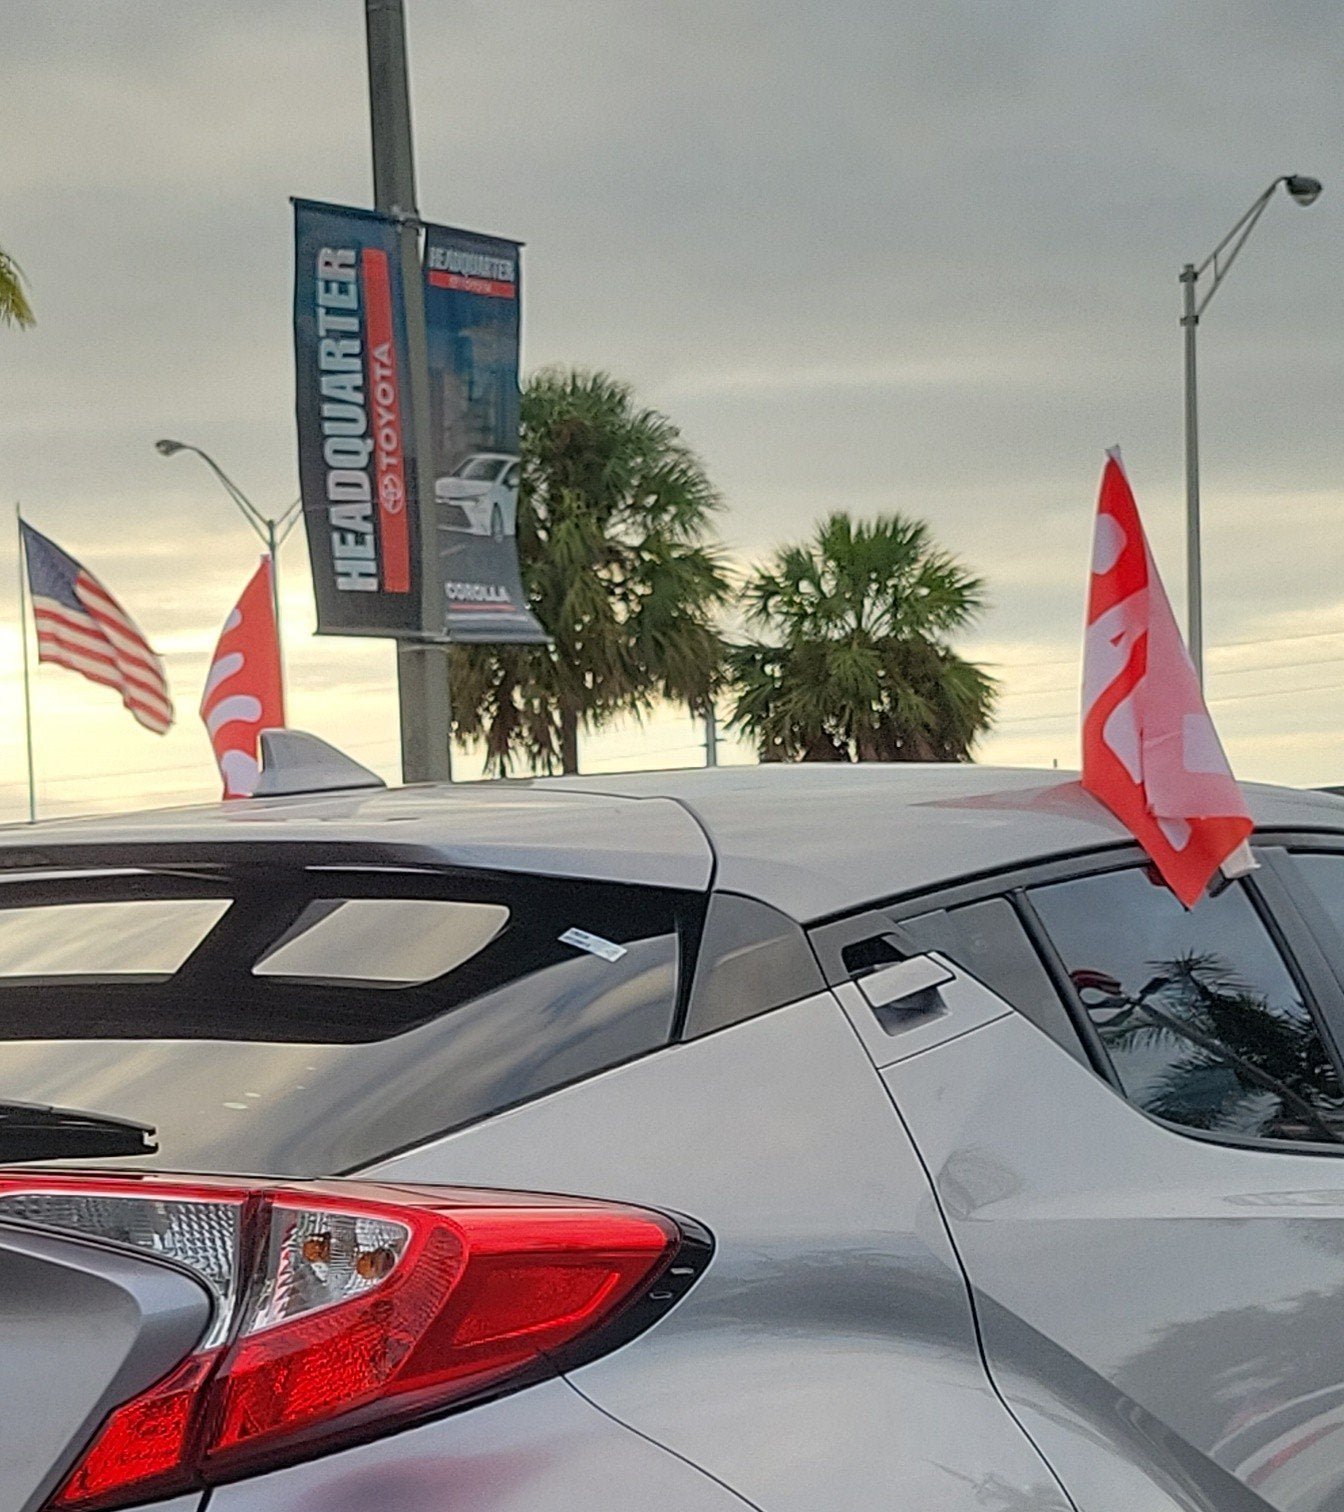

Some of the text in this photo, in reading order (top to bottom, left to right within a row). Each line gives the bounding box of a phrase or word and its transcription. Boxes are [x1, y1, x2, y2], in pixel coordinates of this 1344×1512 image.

[428, 247, 515, 282] HEADQUARTER
[317, 247, 379, 592] HEADQUARTER
[372, 342, 402, 471] TOYOTA
